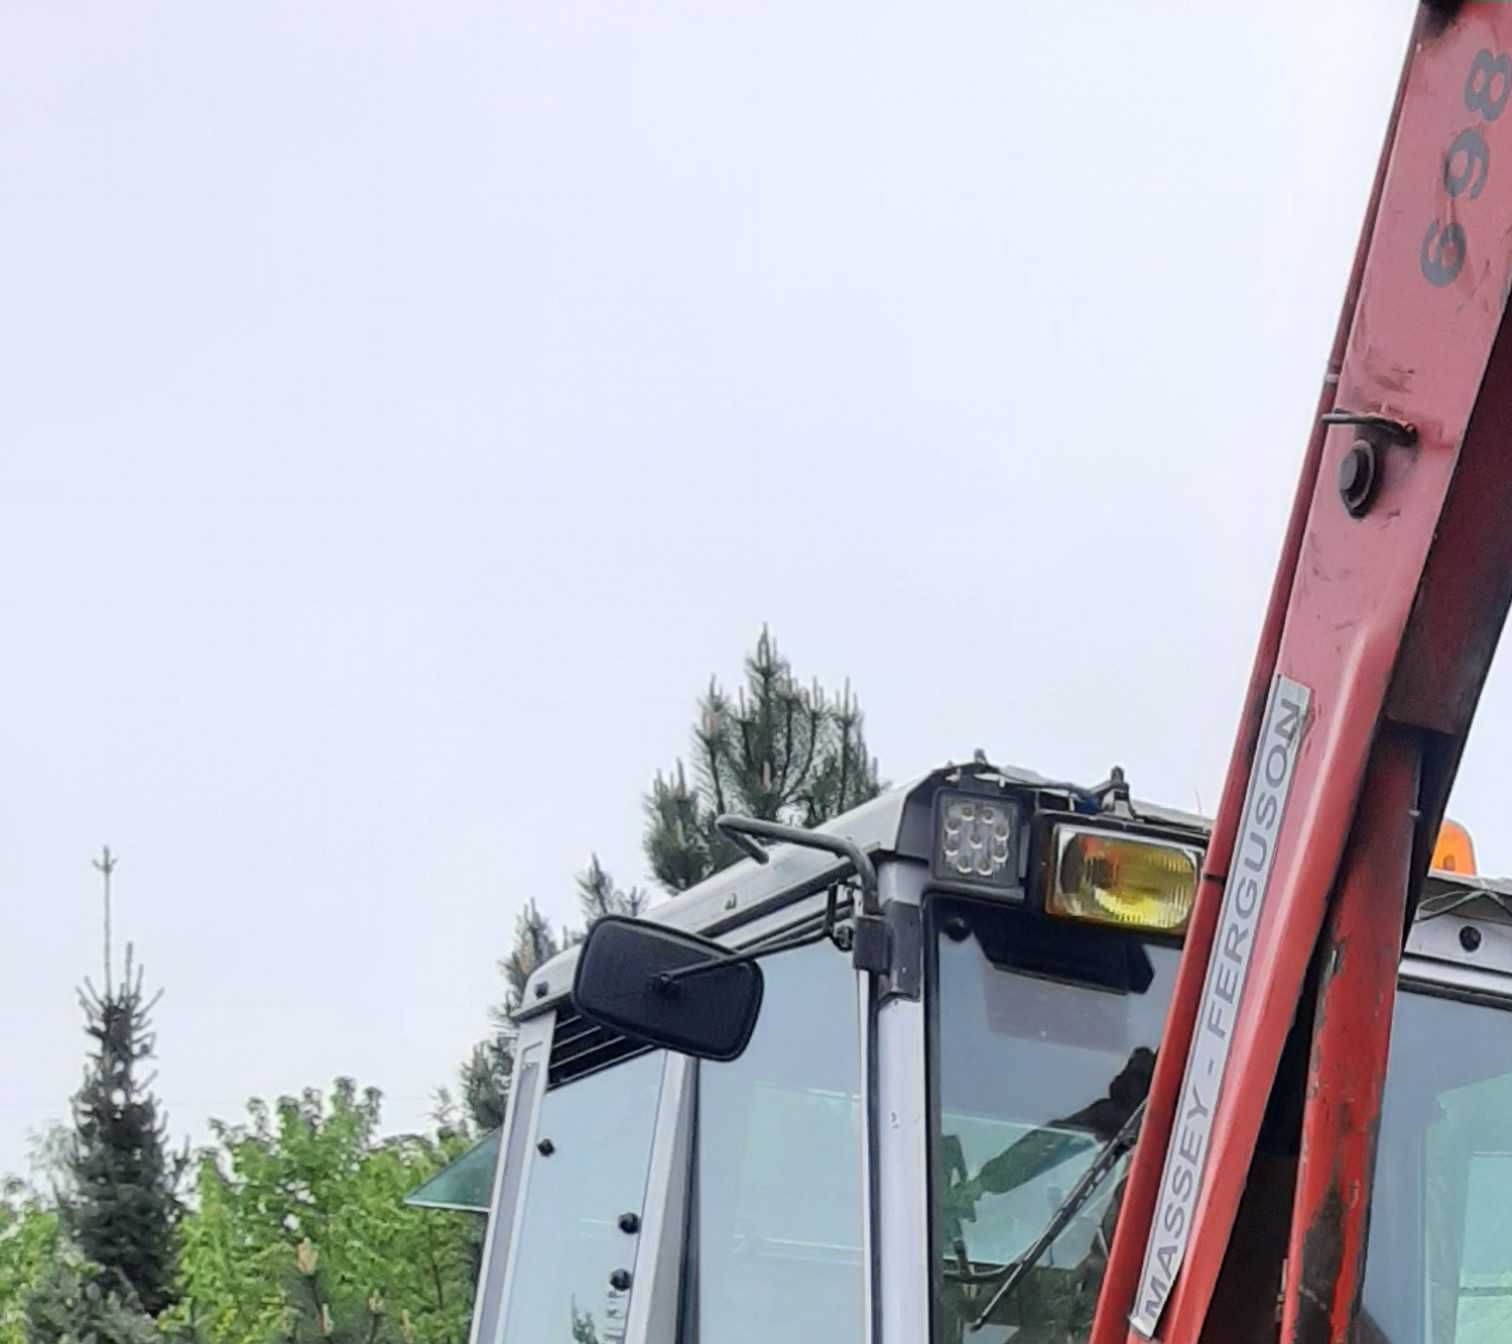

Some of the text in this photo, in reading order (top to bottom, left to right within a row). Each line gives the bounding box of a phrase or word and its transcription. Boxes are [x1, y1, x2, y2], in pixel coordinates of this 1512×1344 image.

[1419, 48, 1512, 288] 698
[1144, 1087, 1209, 1319] MASSEY
[1206, 697, 1302, 1038] FERGUSON
